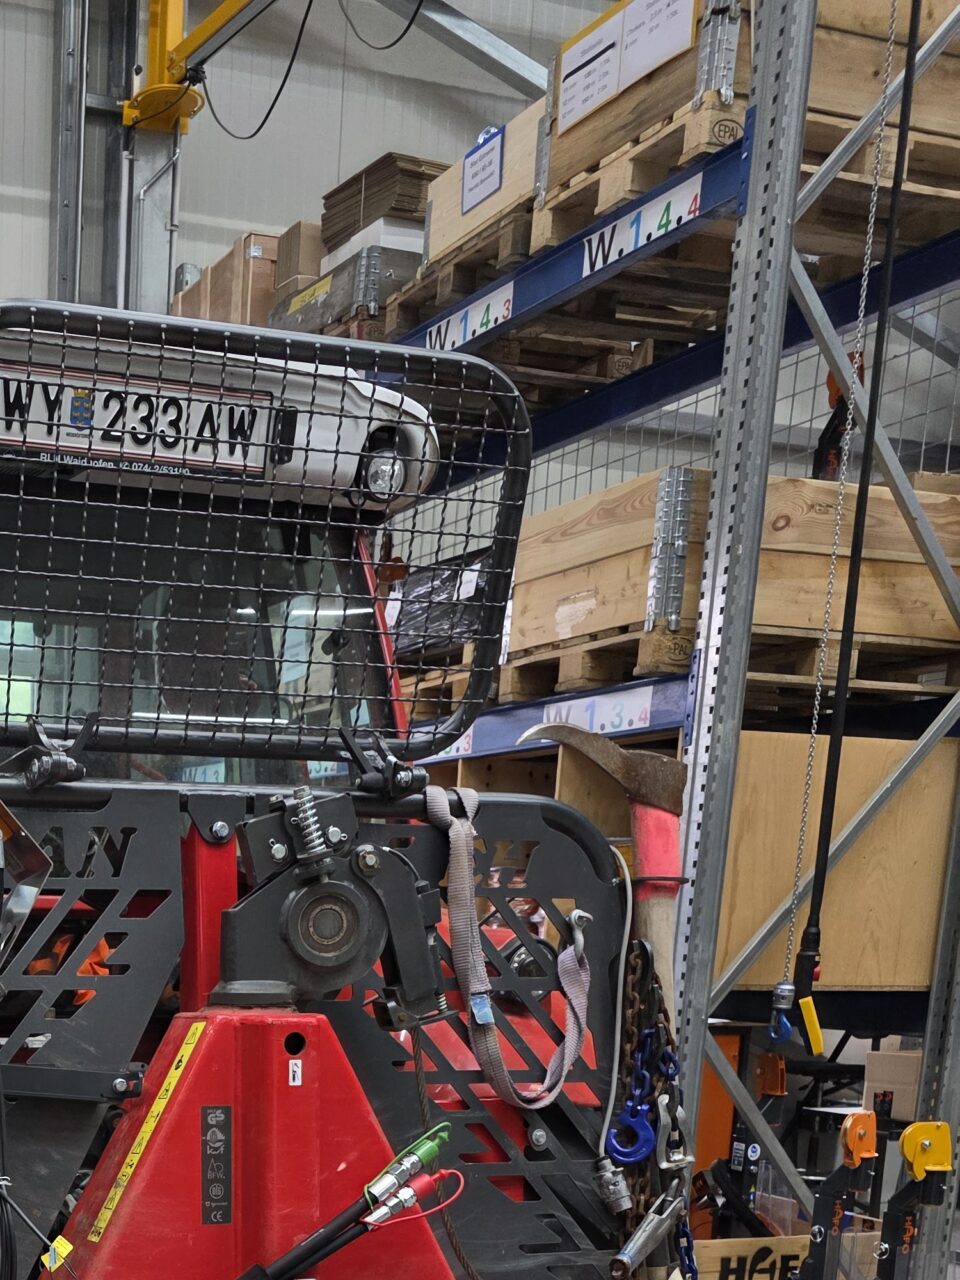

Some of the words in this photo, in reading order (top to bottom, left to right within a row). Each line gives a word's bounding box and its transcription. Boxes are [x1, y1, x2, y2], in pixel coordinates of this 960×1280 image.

[585, 192, 700, 273] W.1.4.4
[428, 298, 512, 350] W.1.4.3
[3, 378, 64, 436] WY
[545, 697, 649, 732] W1.3.4
